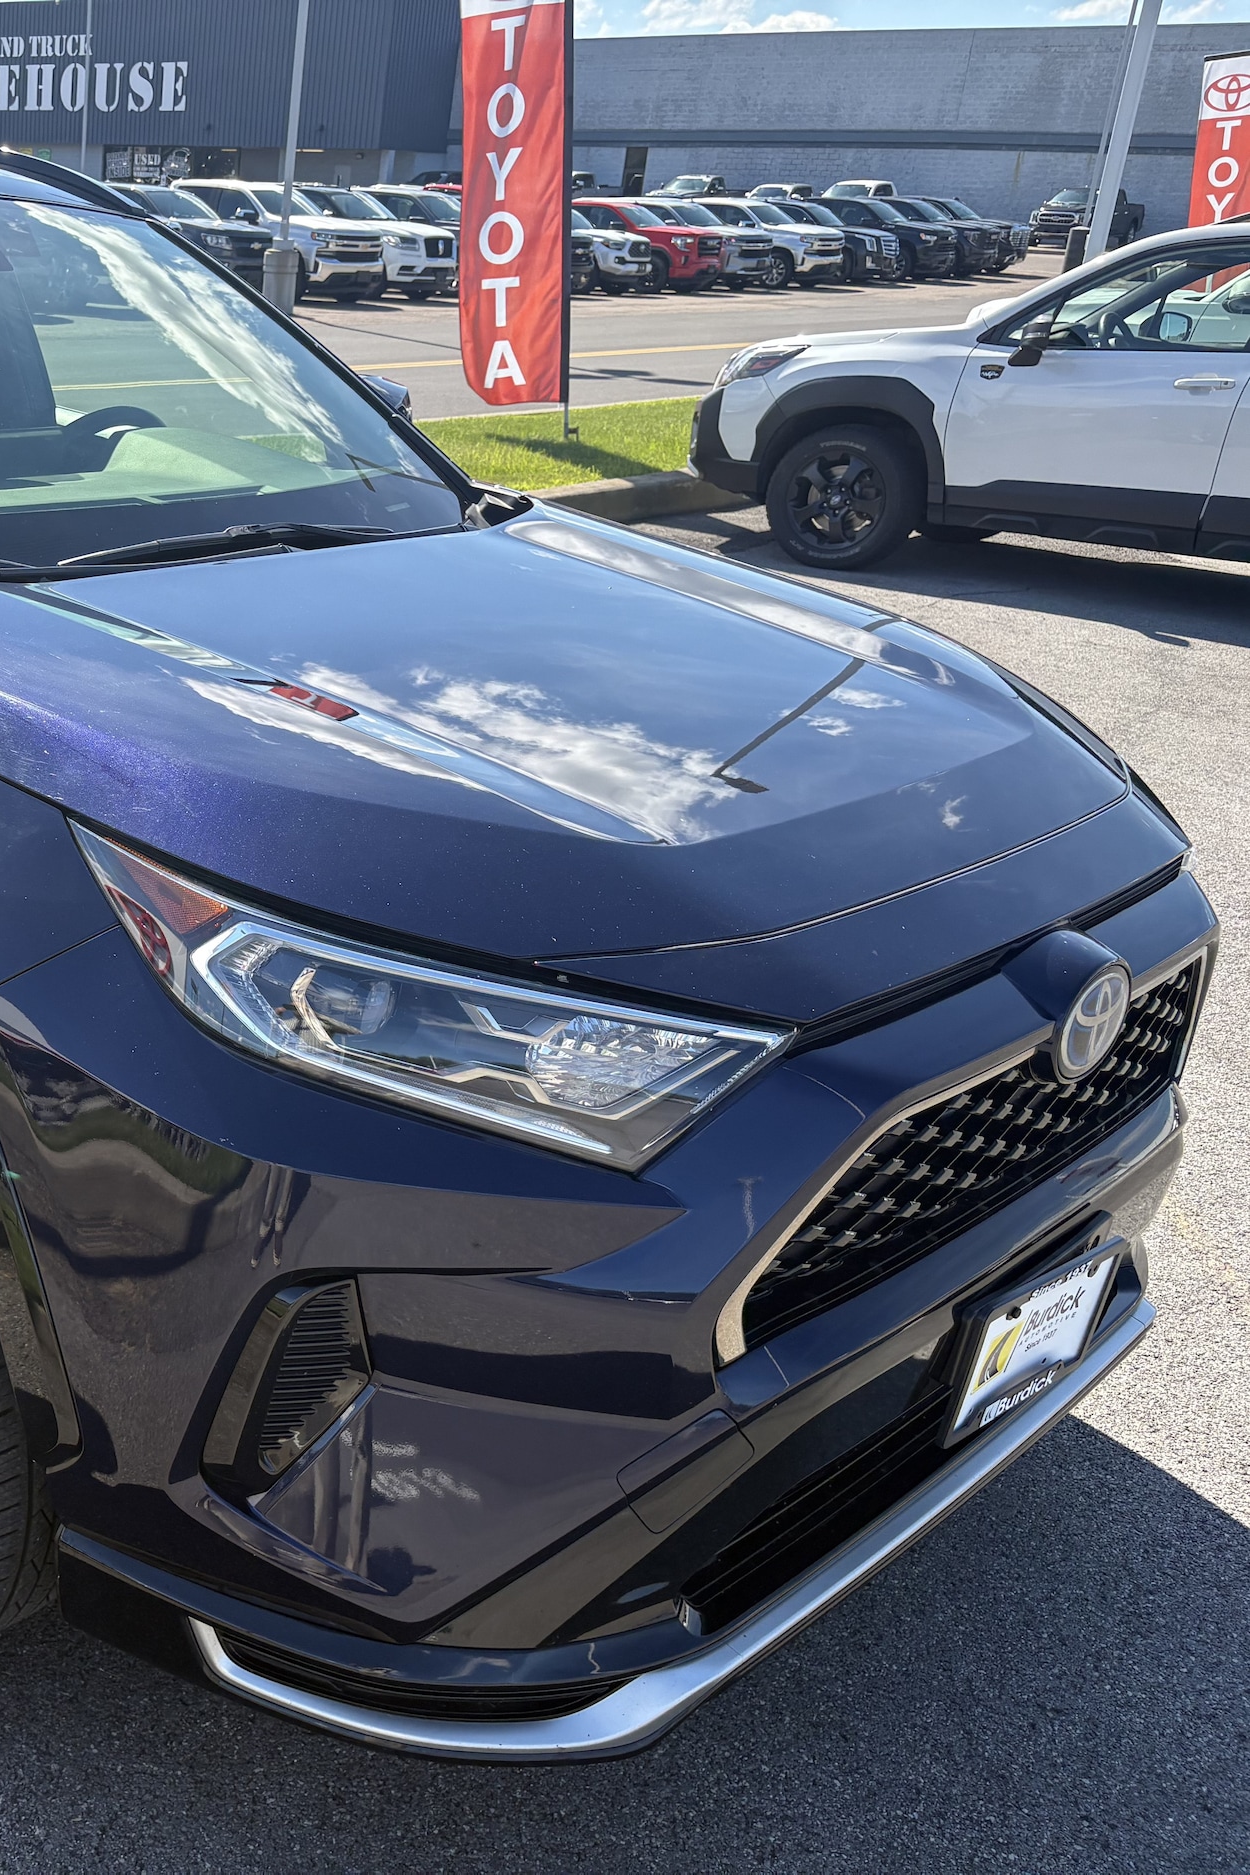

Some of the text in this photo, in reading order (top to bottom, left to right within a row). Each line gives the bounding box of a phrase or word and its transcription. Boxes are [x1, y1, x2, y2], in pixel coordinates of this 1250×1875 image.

[29, 33, 93, 57] TRUCK
[134, 153, 162, 166] USED
[478, 14, 527, 389] TOYOTA
[1029, 1278, 1063, 1300] Since
[1023, 1286, 1086, 1337] Burdick
[1018, 1311, 1077, 1347] AUTOMOTIVE
[1024, 1337, 1042, 1352] Since
[996, 1369, 1056, 1415] Burdick
